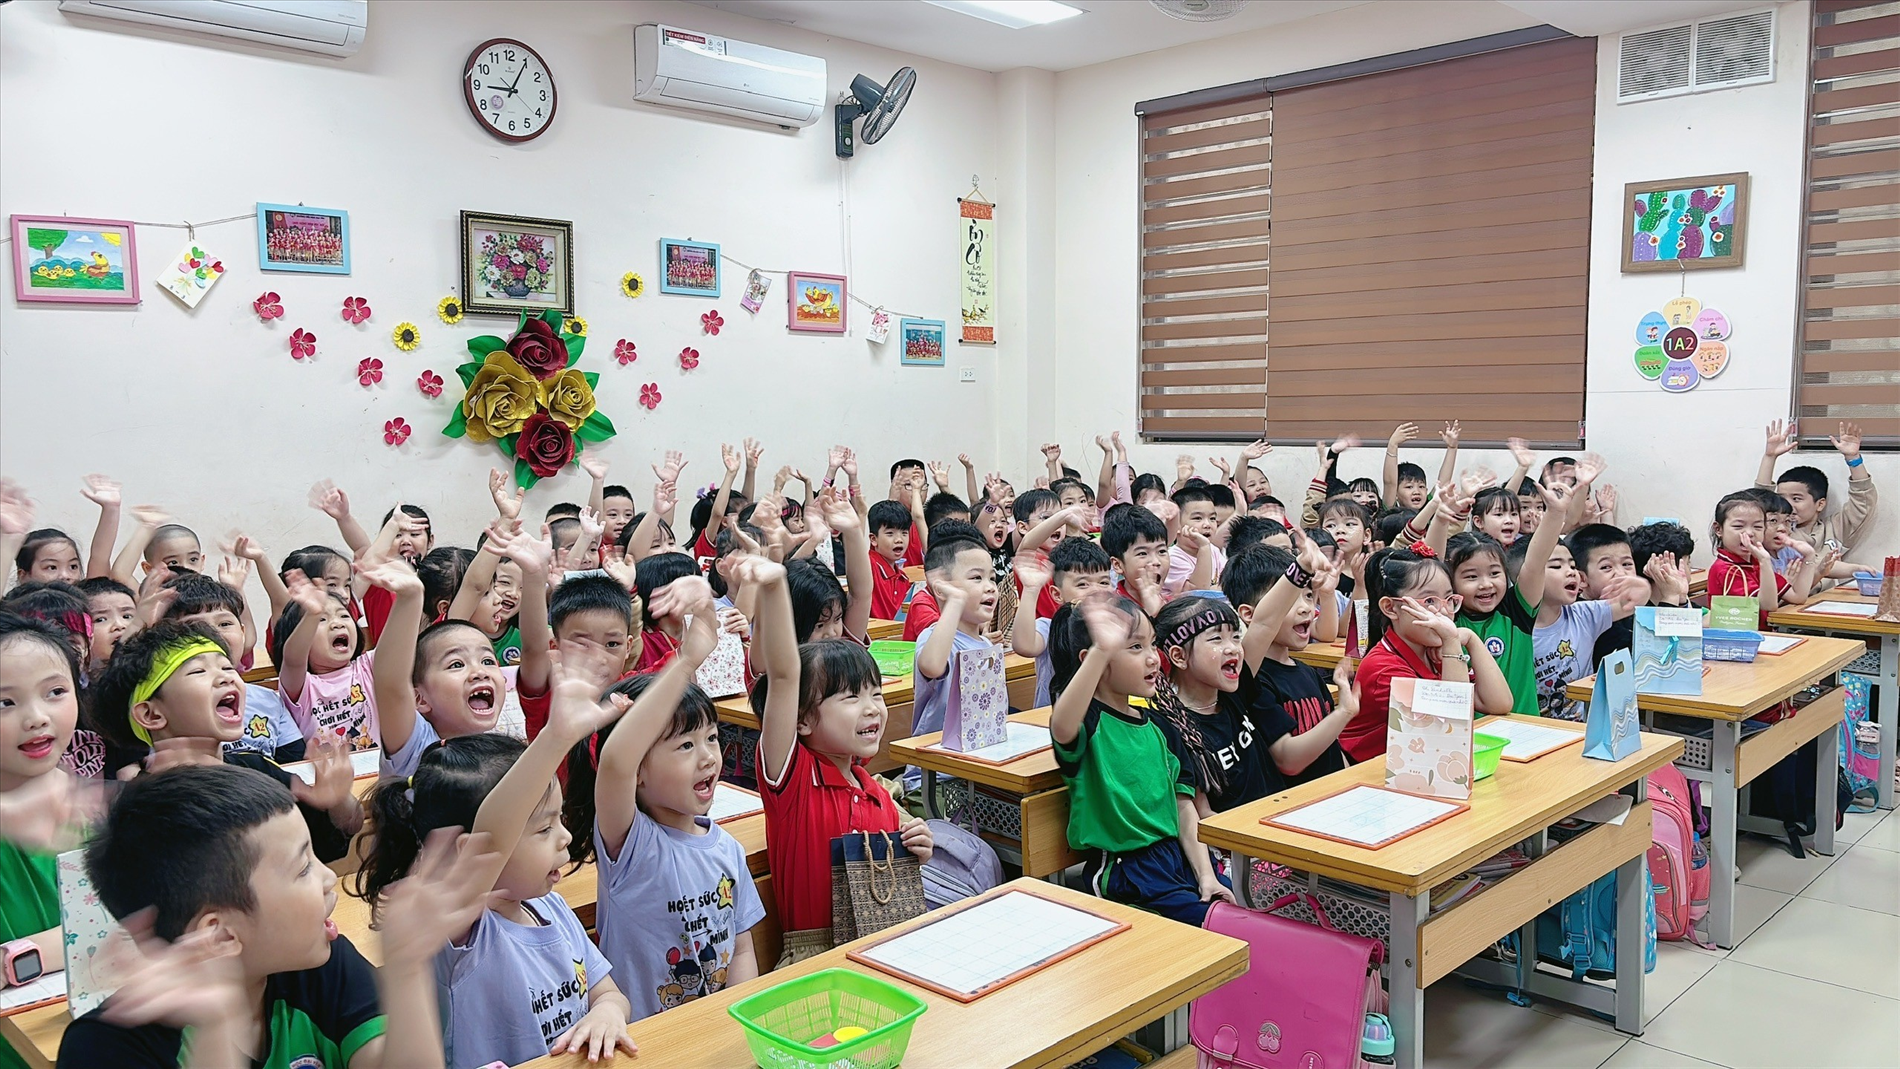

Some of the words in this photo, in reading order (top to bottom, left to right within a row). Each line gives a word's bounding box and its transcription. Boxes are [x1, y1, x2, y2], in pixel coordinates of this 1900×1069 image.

[489, 51, 499, 64] 11
[503, 49, 515, 62] 12
[477, 63, 490, 75] 10
[533, 72, 541, 83] 2
[473, 79, 481, 91] 9
[539, 90, 547, 101] 3
[480, 99, 487, 110] 8
[492, 113, 500, 124] 7
[535, 107, 542, 118] 4
[508, 120, 515, 131] 6
[524, 118, 531, 129] 5
[1666, 337, 1694, 351] 1A2
[323, 700, 340, 713] HẾT
[336, 709, 351, 721] HẾT
[698, 890, 718, 908] SỨC
[557, 980, 579, 1002] SỨC
[552, 1009, 572, 1032] HẾT
